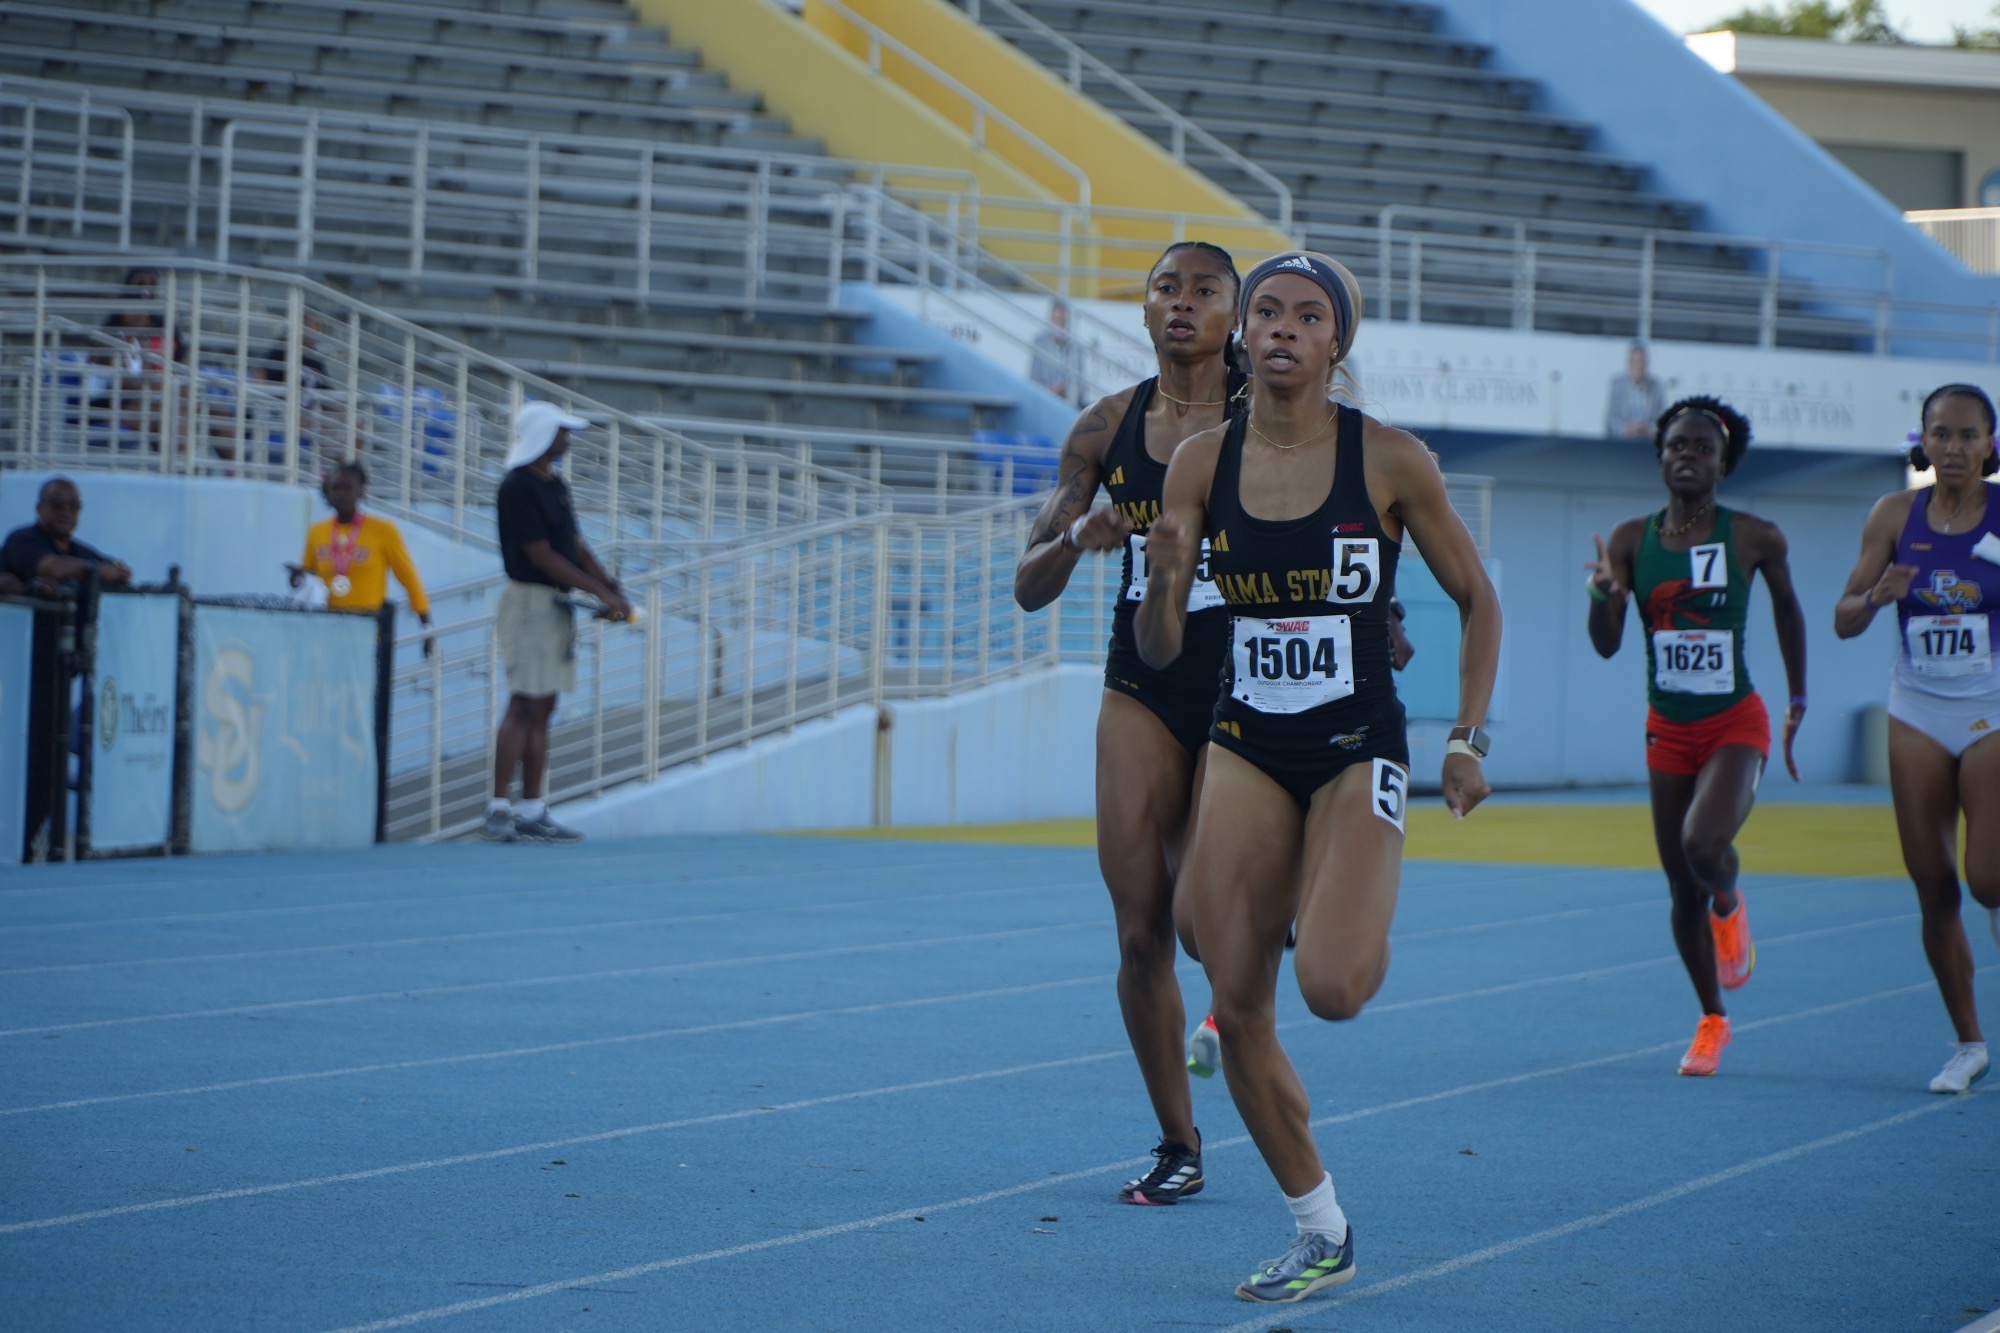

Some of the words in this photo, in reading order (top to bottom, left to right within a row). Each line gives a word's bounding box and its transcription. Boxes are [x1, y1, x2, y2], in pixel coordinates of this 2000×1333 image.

[1336, 543, 1373, 600] 5
[1696, 548, 1720, 583] 7
[1275, 620, 1310, 633] SWAC
[1920, 627, 1976, 656] 1774
[1244, 636, 1339, 680] 1504
[1663, 642, 1724, 671] 1625
[1378, 764, 1404, 822] 5
